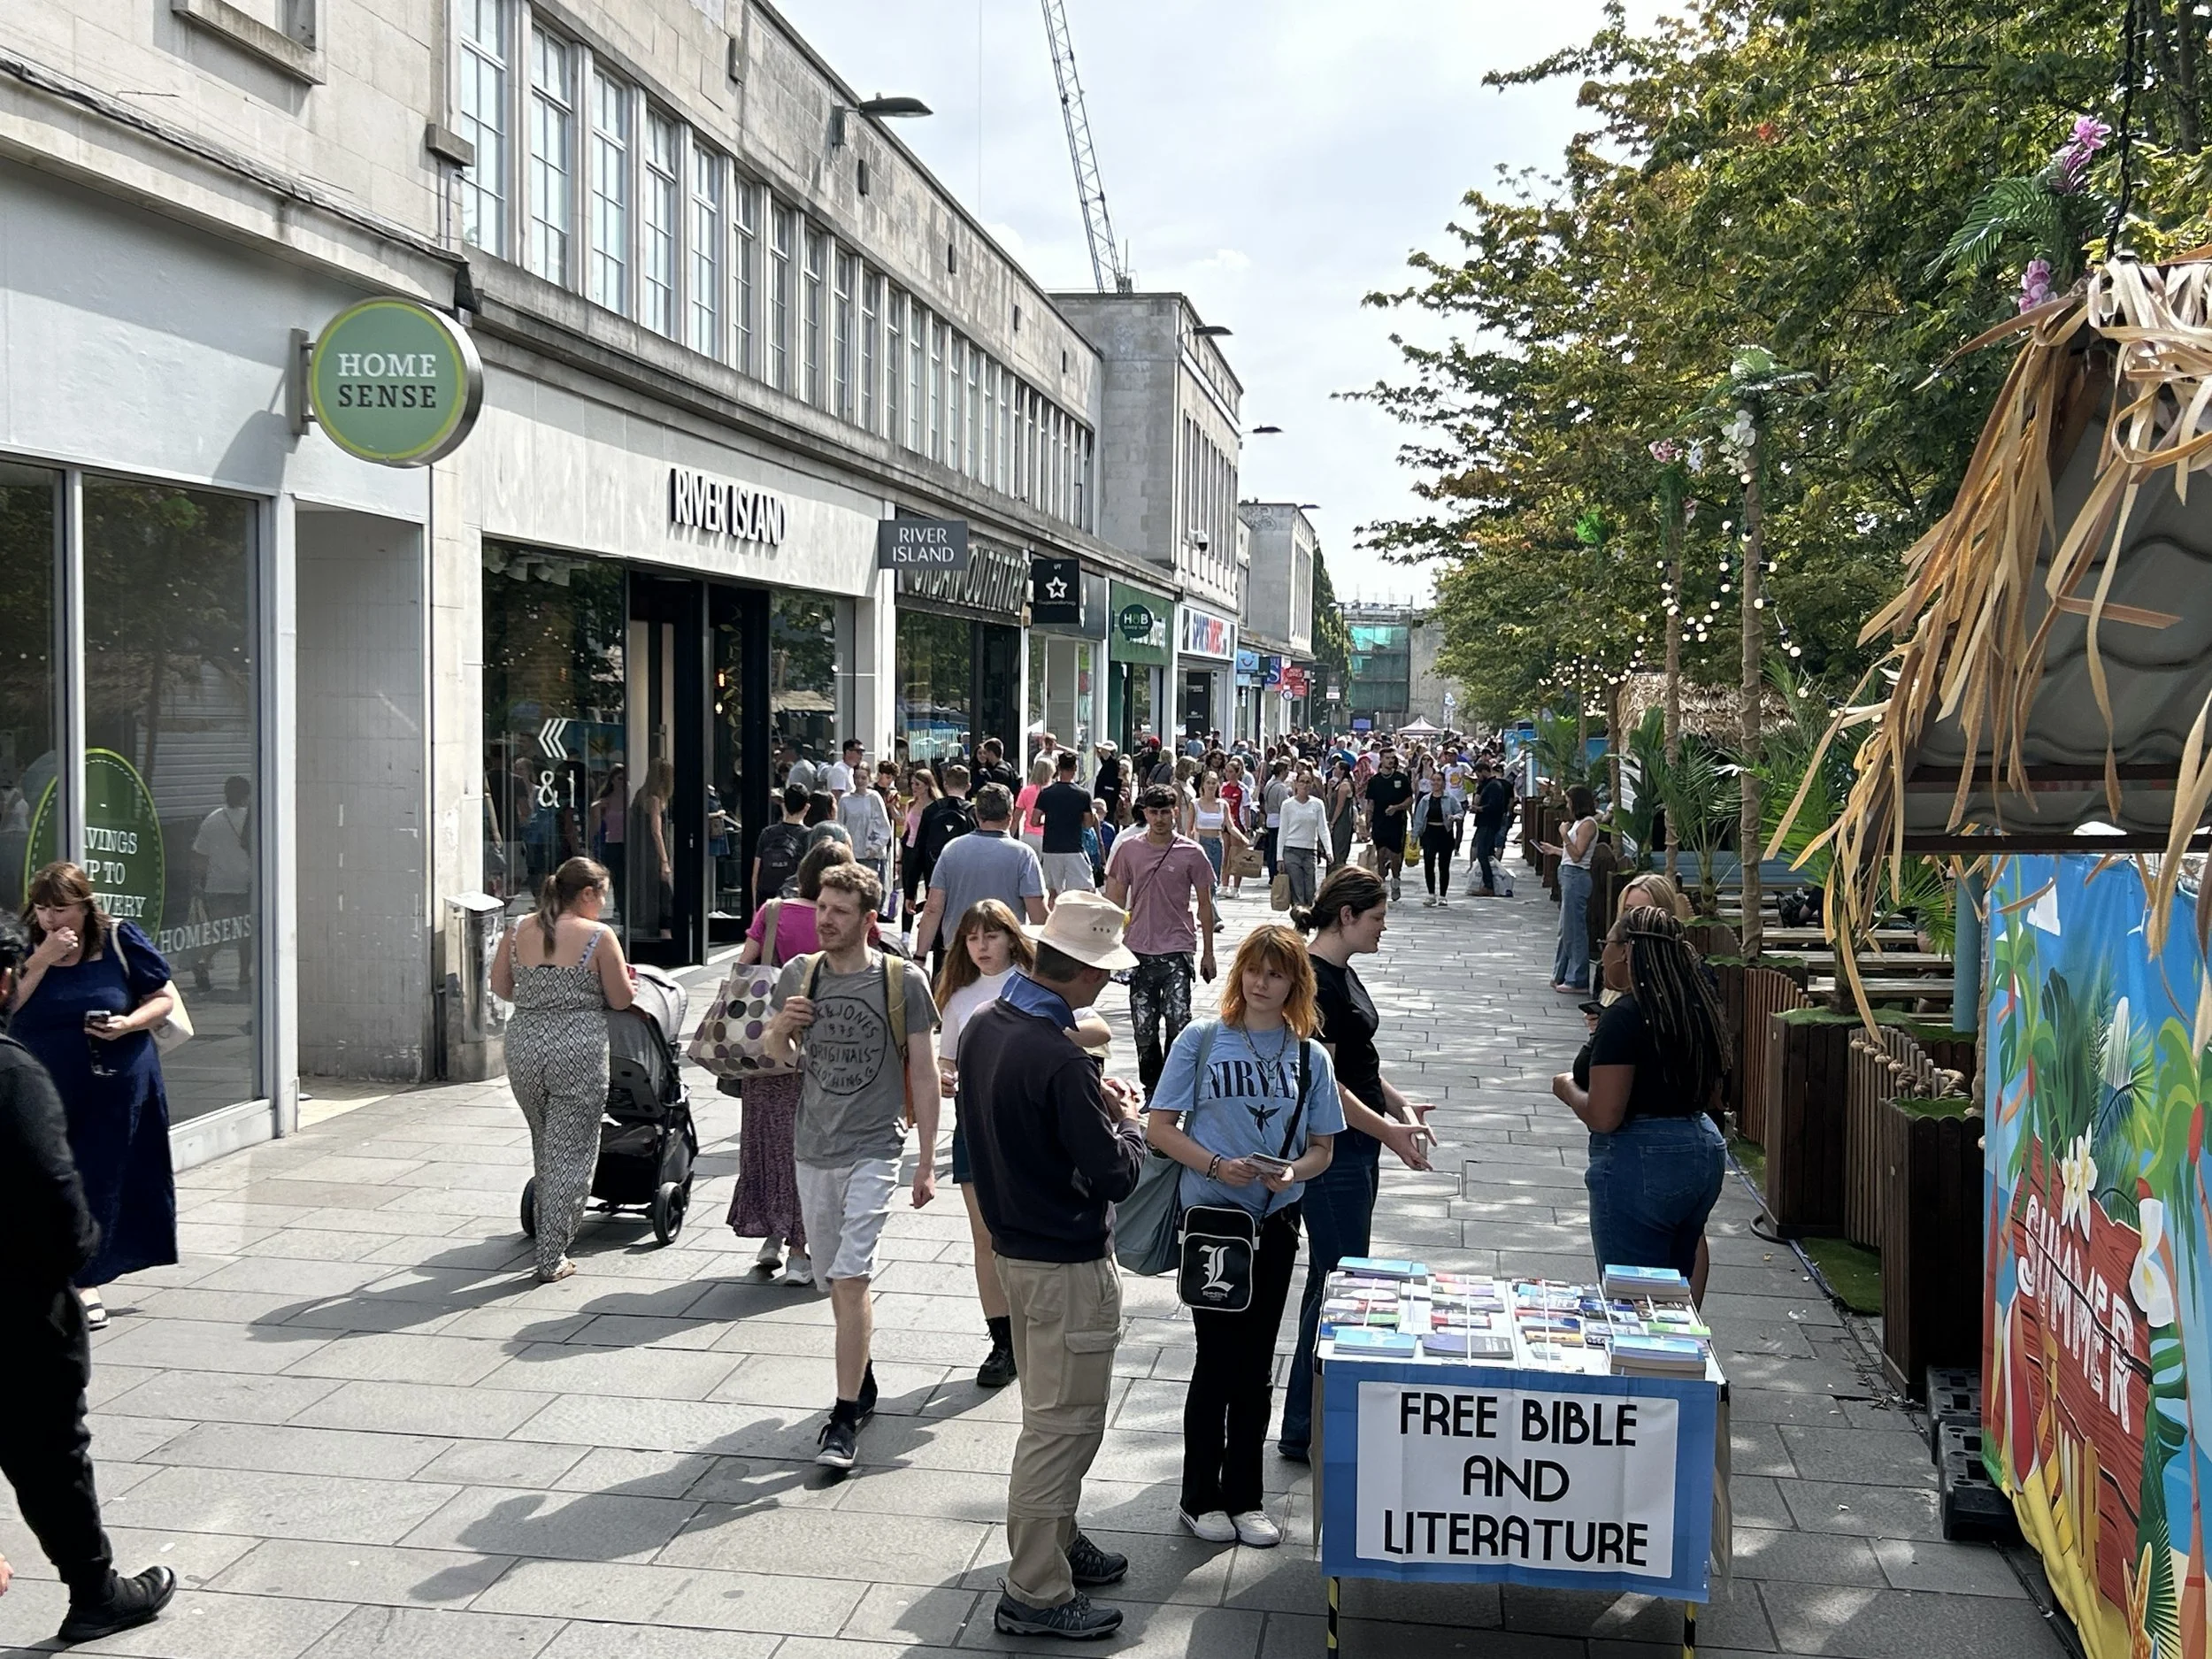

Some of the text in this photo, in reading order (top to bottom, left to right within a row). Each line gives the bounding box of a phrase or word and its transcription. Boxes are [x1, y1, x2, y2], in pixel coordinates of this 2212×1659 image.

[337, 353, 437, 378] HOME
[337, 384, 437, 409] SENSE
[671, 467, 787, 546] RIVER ISLAND
[899, 527, 948, 544] RIVER
[892, 546, 955, 563] ISLAND
[83, 826, 138, 855] VINGS
[86, 859, 127, 885] P TO
[810, 1042, 872, 1064] ORIGINALS
[811, 1060, 864, 1087] CLOTHING
[2017, 1193, 2134, 1435] SUMMER
[1400, 1392, 1638, 1447] FREE BIBLE
[1463, 1455, 1570, 1502] AND
[1384, 1509, 1648, 1567] LITERATURE
